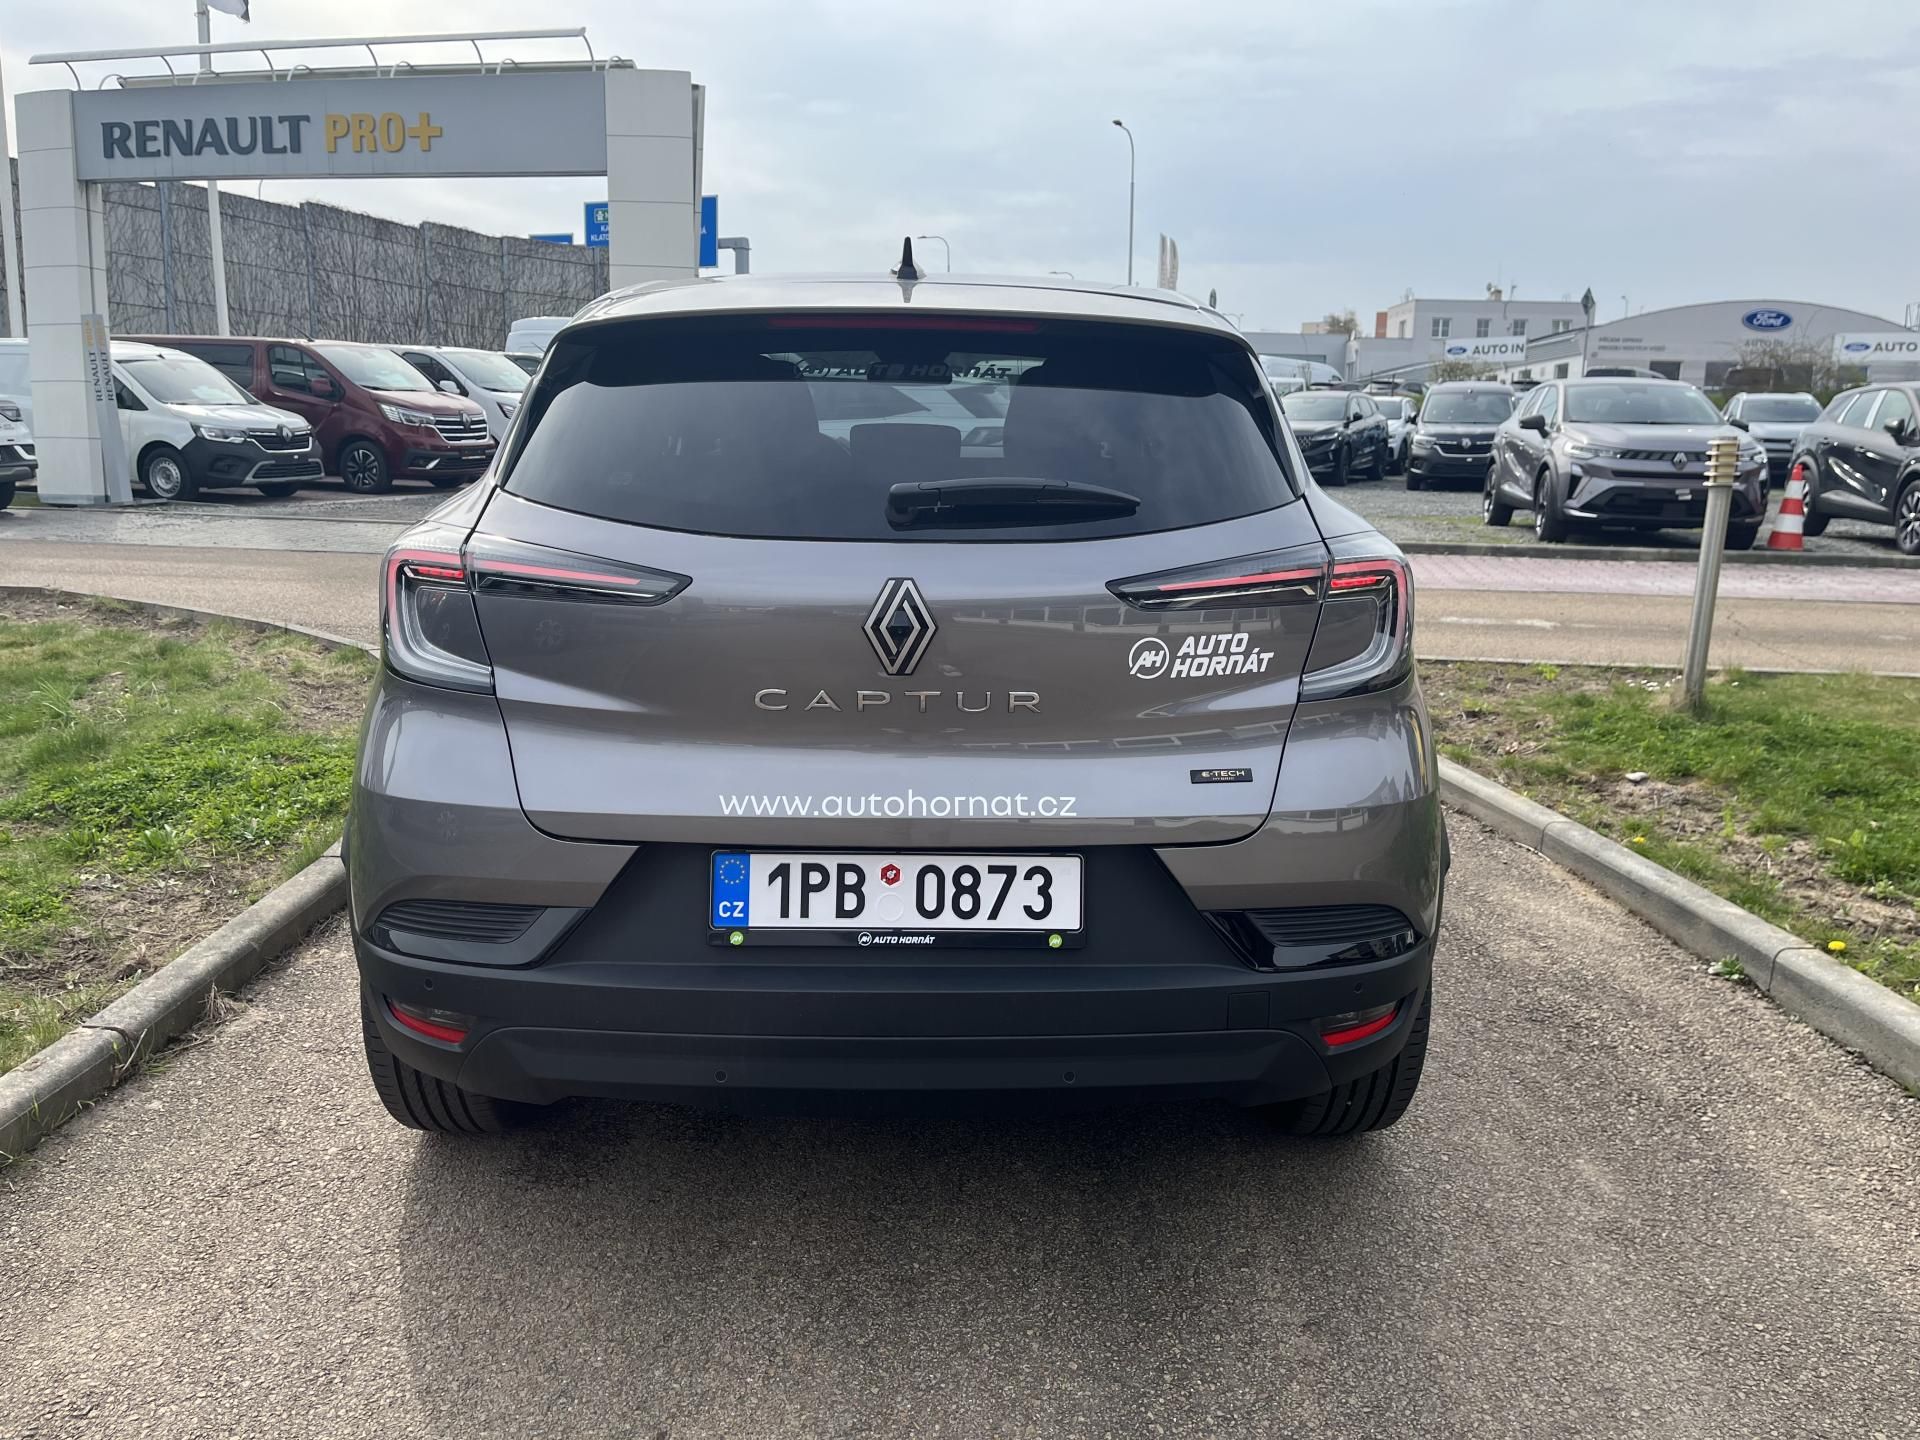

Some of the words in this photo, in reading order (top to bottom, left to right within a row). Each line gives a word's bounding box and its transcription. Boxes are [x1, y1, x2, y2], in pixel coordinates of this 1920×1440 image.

[101, 115, 311, 159] RENAULT
[325, 111, 443, 153] PRO+
[1472, 344, 1509, 355] AUTO
[1511, 343, 1525, 353] IN
[1874, 342, 1918, 353] AUTO
[88, 352, 104, 402] RENAULT
[100, 352, 115, 401] RENAULT
[1176, 632, 1249, 656] AUTO
[1170, 647, 1275, 678] HORNÁT
[754, 688, 1041, 713] CAPTUR
[718, 789, 1077, 817] www.autohornat.cz
[768, 862, 867, 919] 1PB
[915, 863, 1054, 921] 0873
[718, 901, 745, 919] CZ
[873, 936, 898, 944] AUTO
[899, 935, 936, 945] HORNÁT
